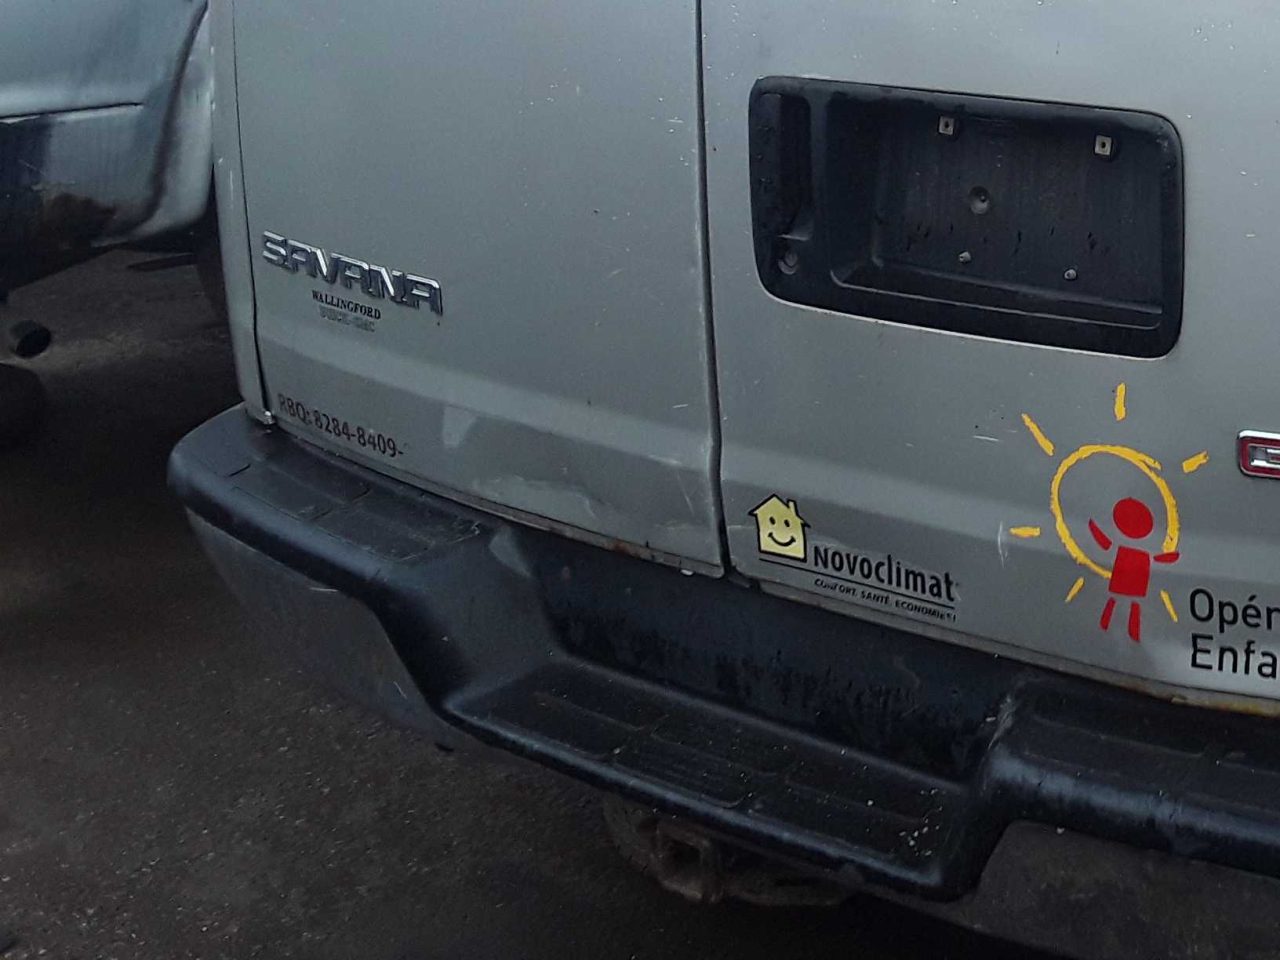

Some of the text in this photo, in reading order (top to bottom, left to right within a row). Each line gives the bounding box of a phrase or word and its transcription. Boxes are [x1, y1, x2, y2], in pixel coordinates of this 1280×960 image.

[261, 230, 443, 317] SAVANA
[311, 289, 382, 320] WALLINGFORD
[813, 545, 955, 602] Novoclimat
